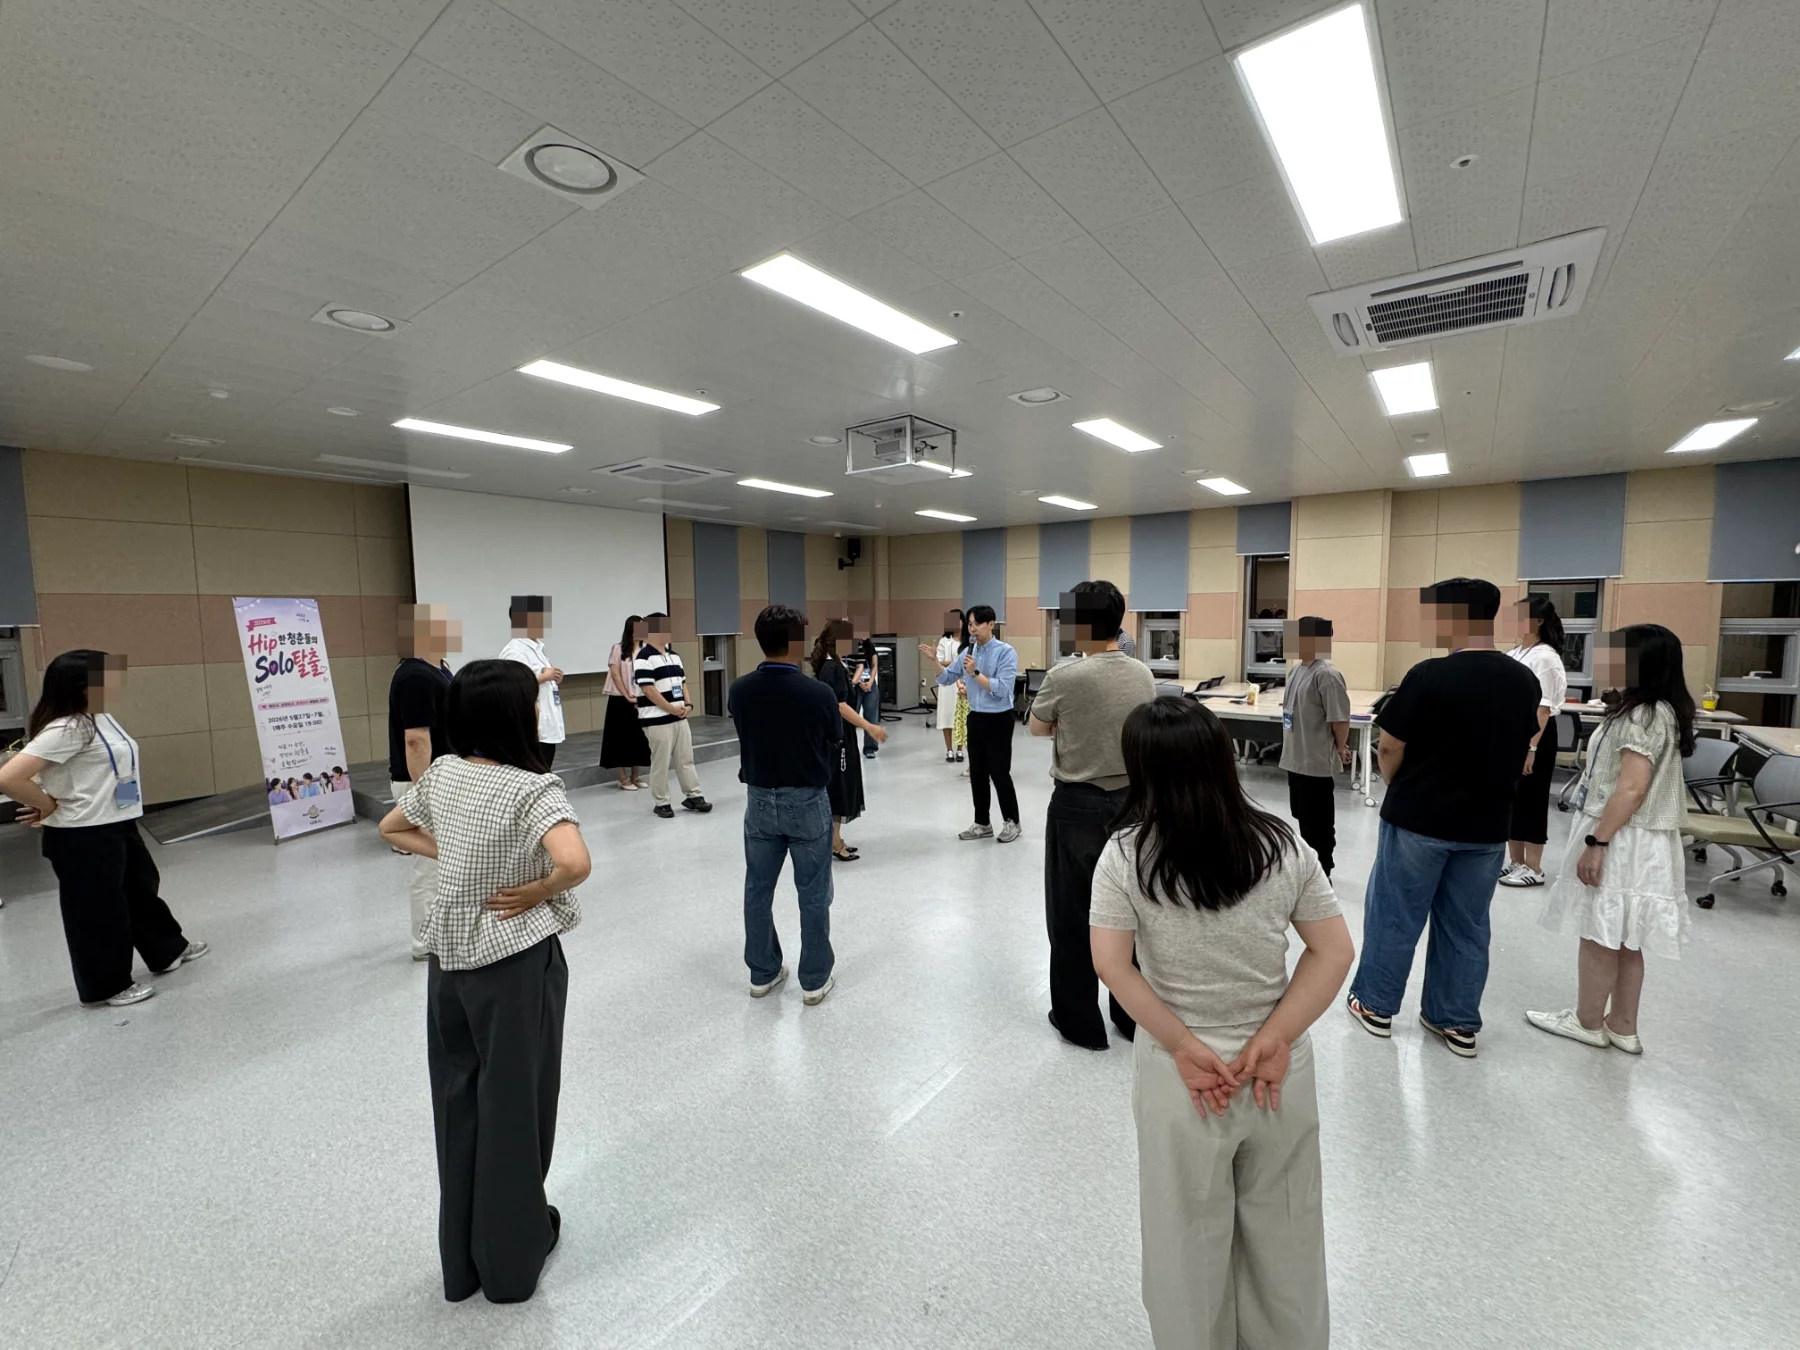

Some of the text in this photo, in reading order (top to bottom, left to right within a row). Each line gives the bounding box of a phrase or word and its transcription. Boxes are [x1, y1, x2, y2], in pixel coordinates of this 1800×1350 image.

[287, 632, 318, 645] 청춘들의
[268, 714, 288, 723] 2026년
[272, 723, 286, 732] (매주
[287, 721, 303, 730] 수요일
